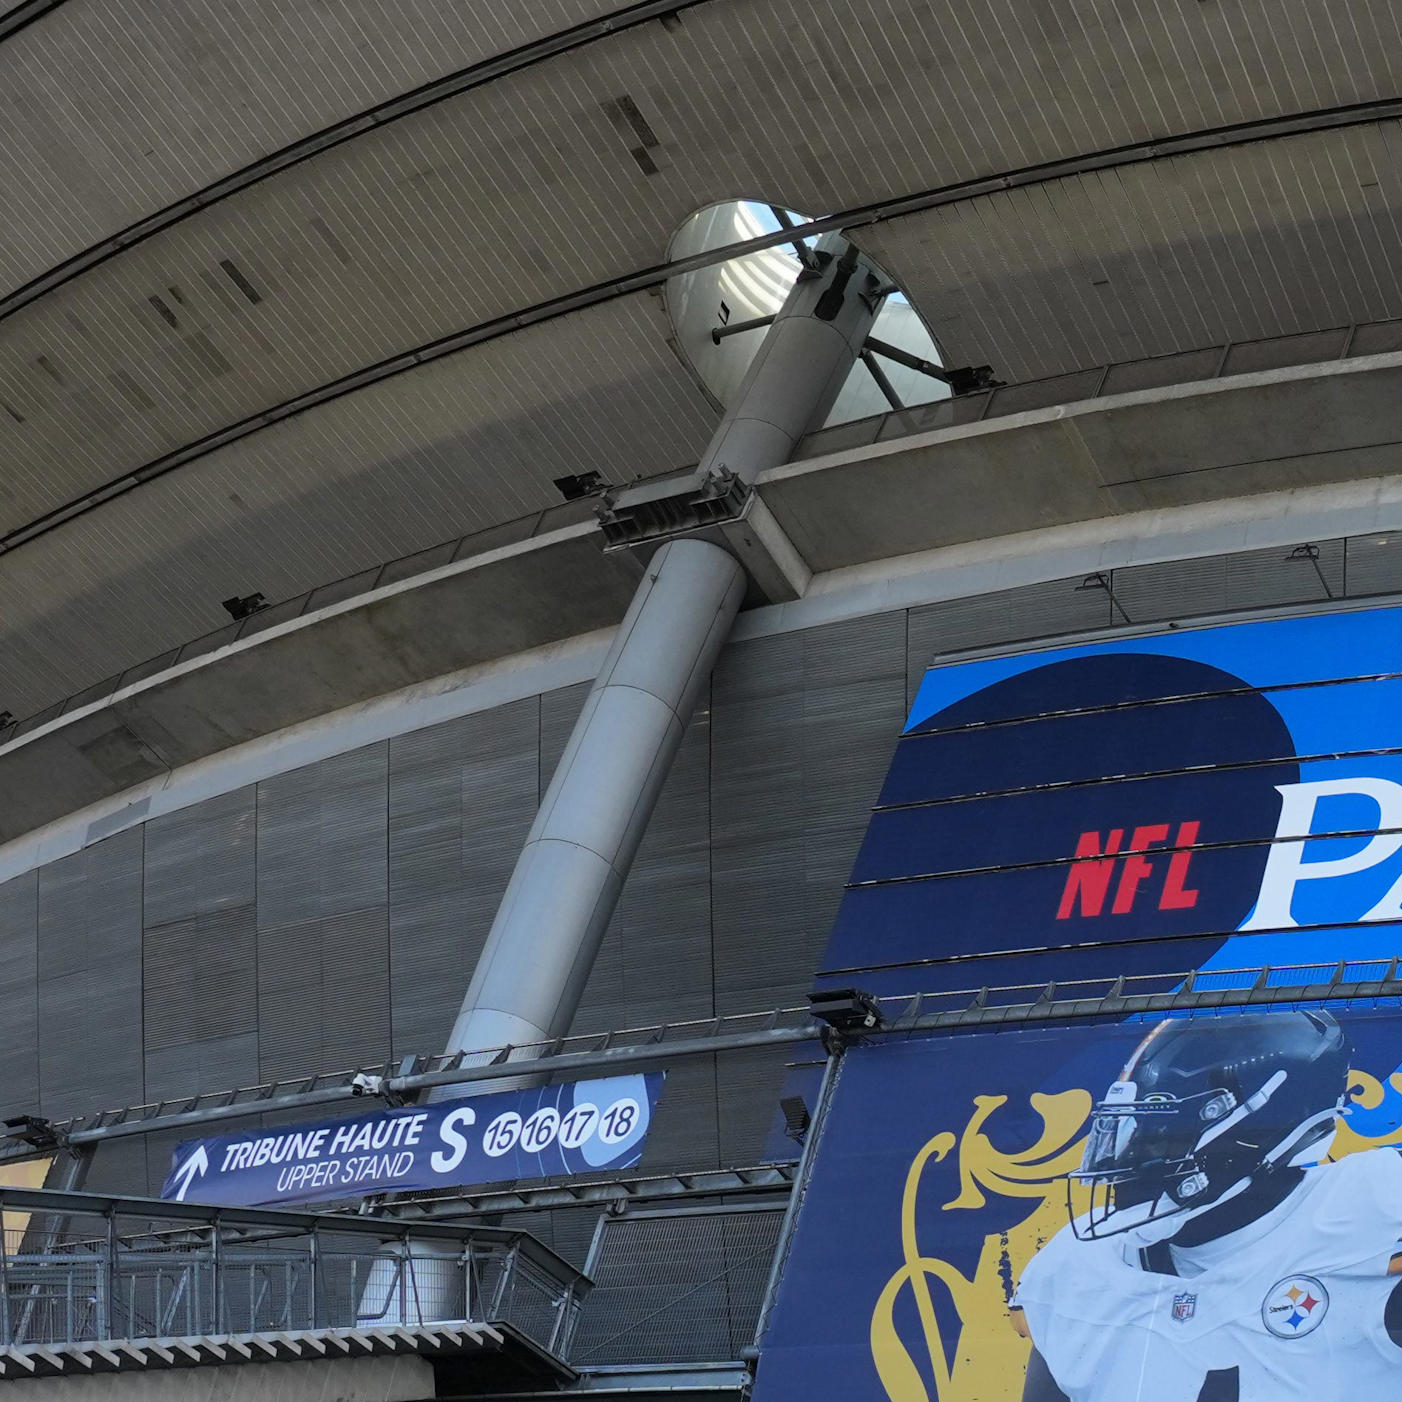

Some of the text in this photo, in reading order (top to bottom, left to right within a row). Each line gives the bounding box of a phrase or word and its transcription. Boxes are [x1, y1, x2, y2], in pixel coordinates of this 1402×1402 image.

[1055, 820, 1202, 921] NFL
[220, 1113, 429, 1172] TRIBUNE HAUTE
[430, 1105, 635, 1173] S 15 16 17 18
[277, 1151, 414, 1192] UPPER STAND
[1175, 1305, 1192, 1319] NFL
